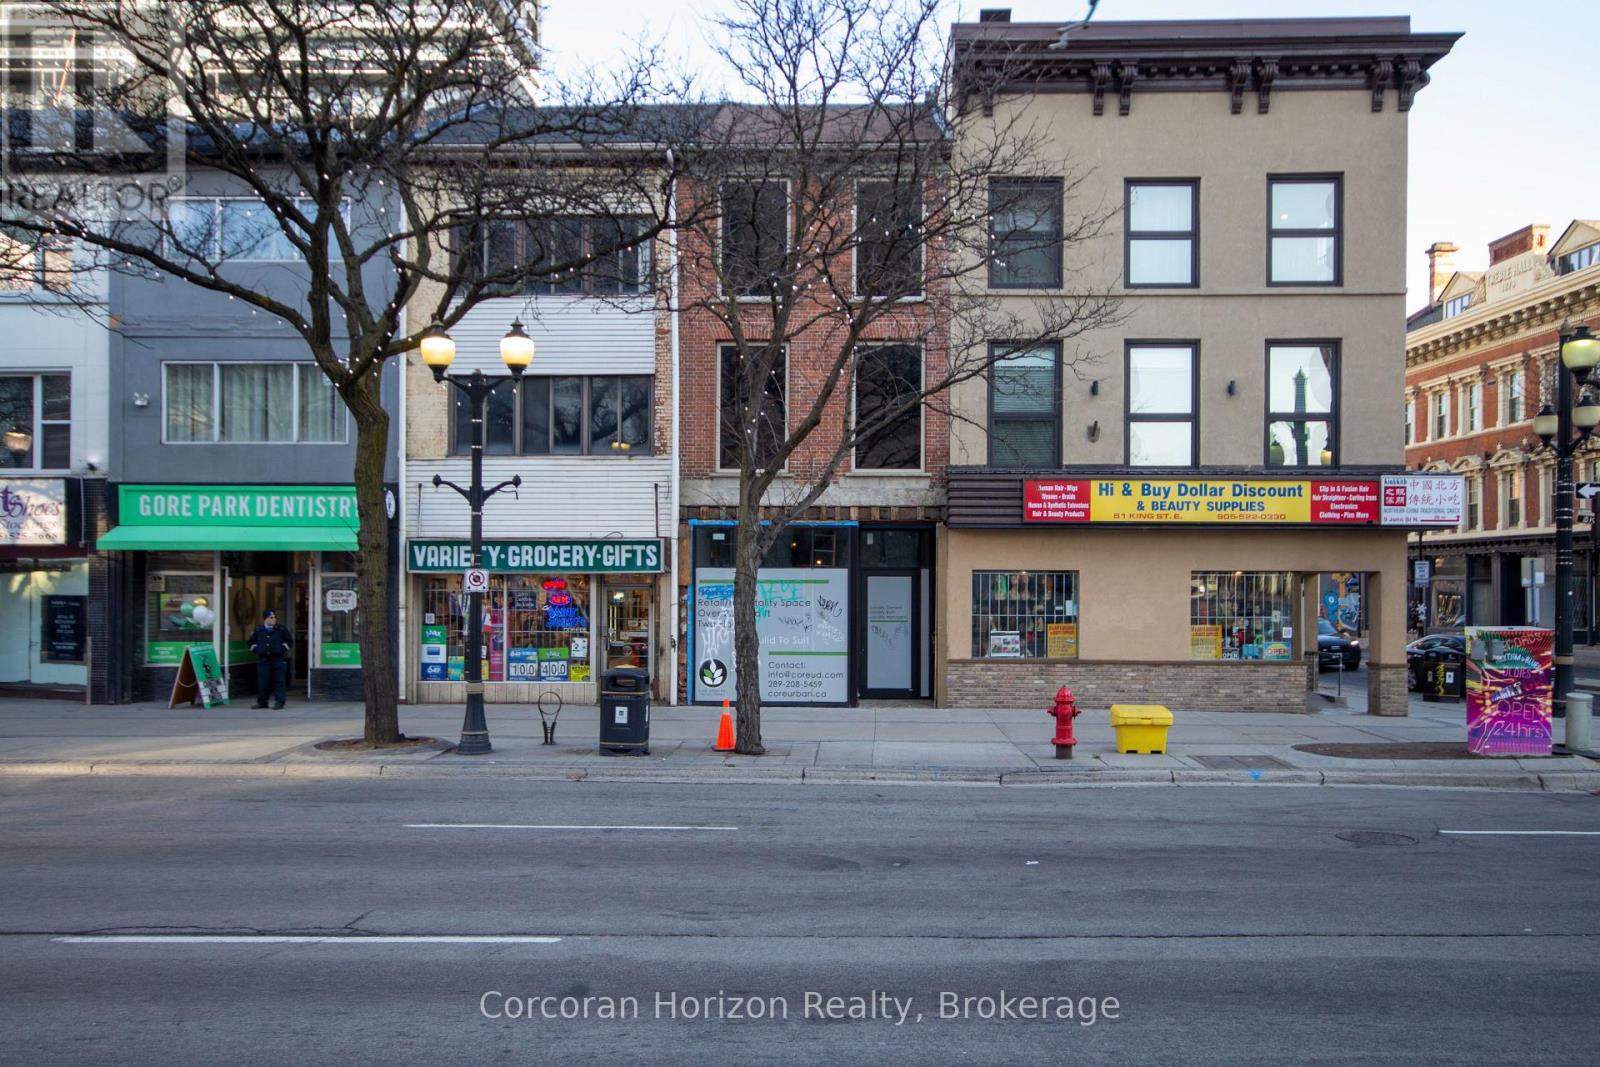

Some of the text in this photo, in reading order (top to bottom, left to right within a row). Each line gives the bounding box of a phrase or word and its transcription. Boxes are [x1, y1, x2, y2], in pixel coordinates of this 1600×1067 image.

[1098, 483, 1303, 499] Hi & Buy Dollar Discount
[139, 495, 192, 517] GORE
[198, 495, 250, 517] PARK
[1136, 501, 1265, 511] & BEAUTY SUPPLIES
[780, 600, 811, 608] Space
[777, 635, 789, 645] To
[792, 635, 809, 645] Suit
[768, 680, 823, 688] 289-208-5459
[768, 690, 827, 698] coreurban.ca
[1496, 700, 1546, 721] OPEN
